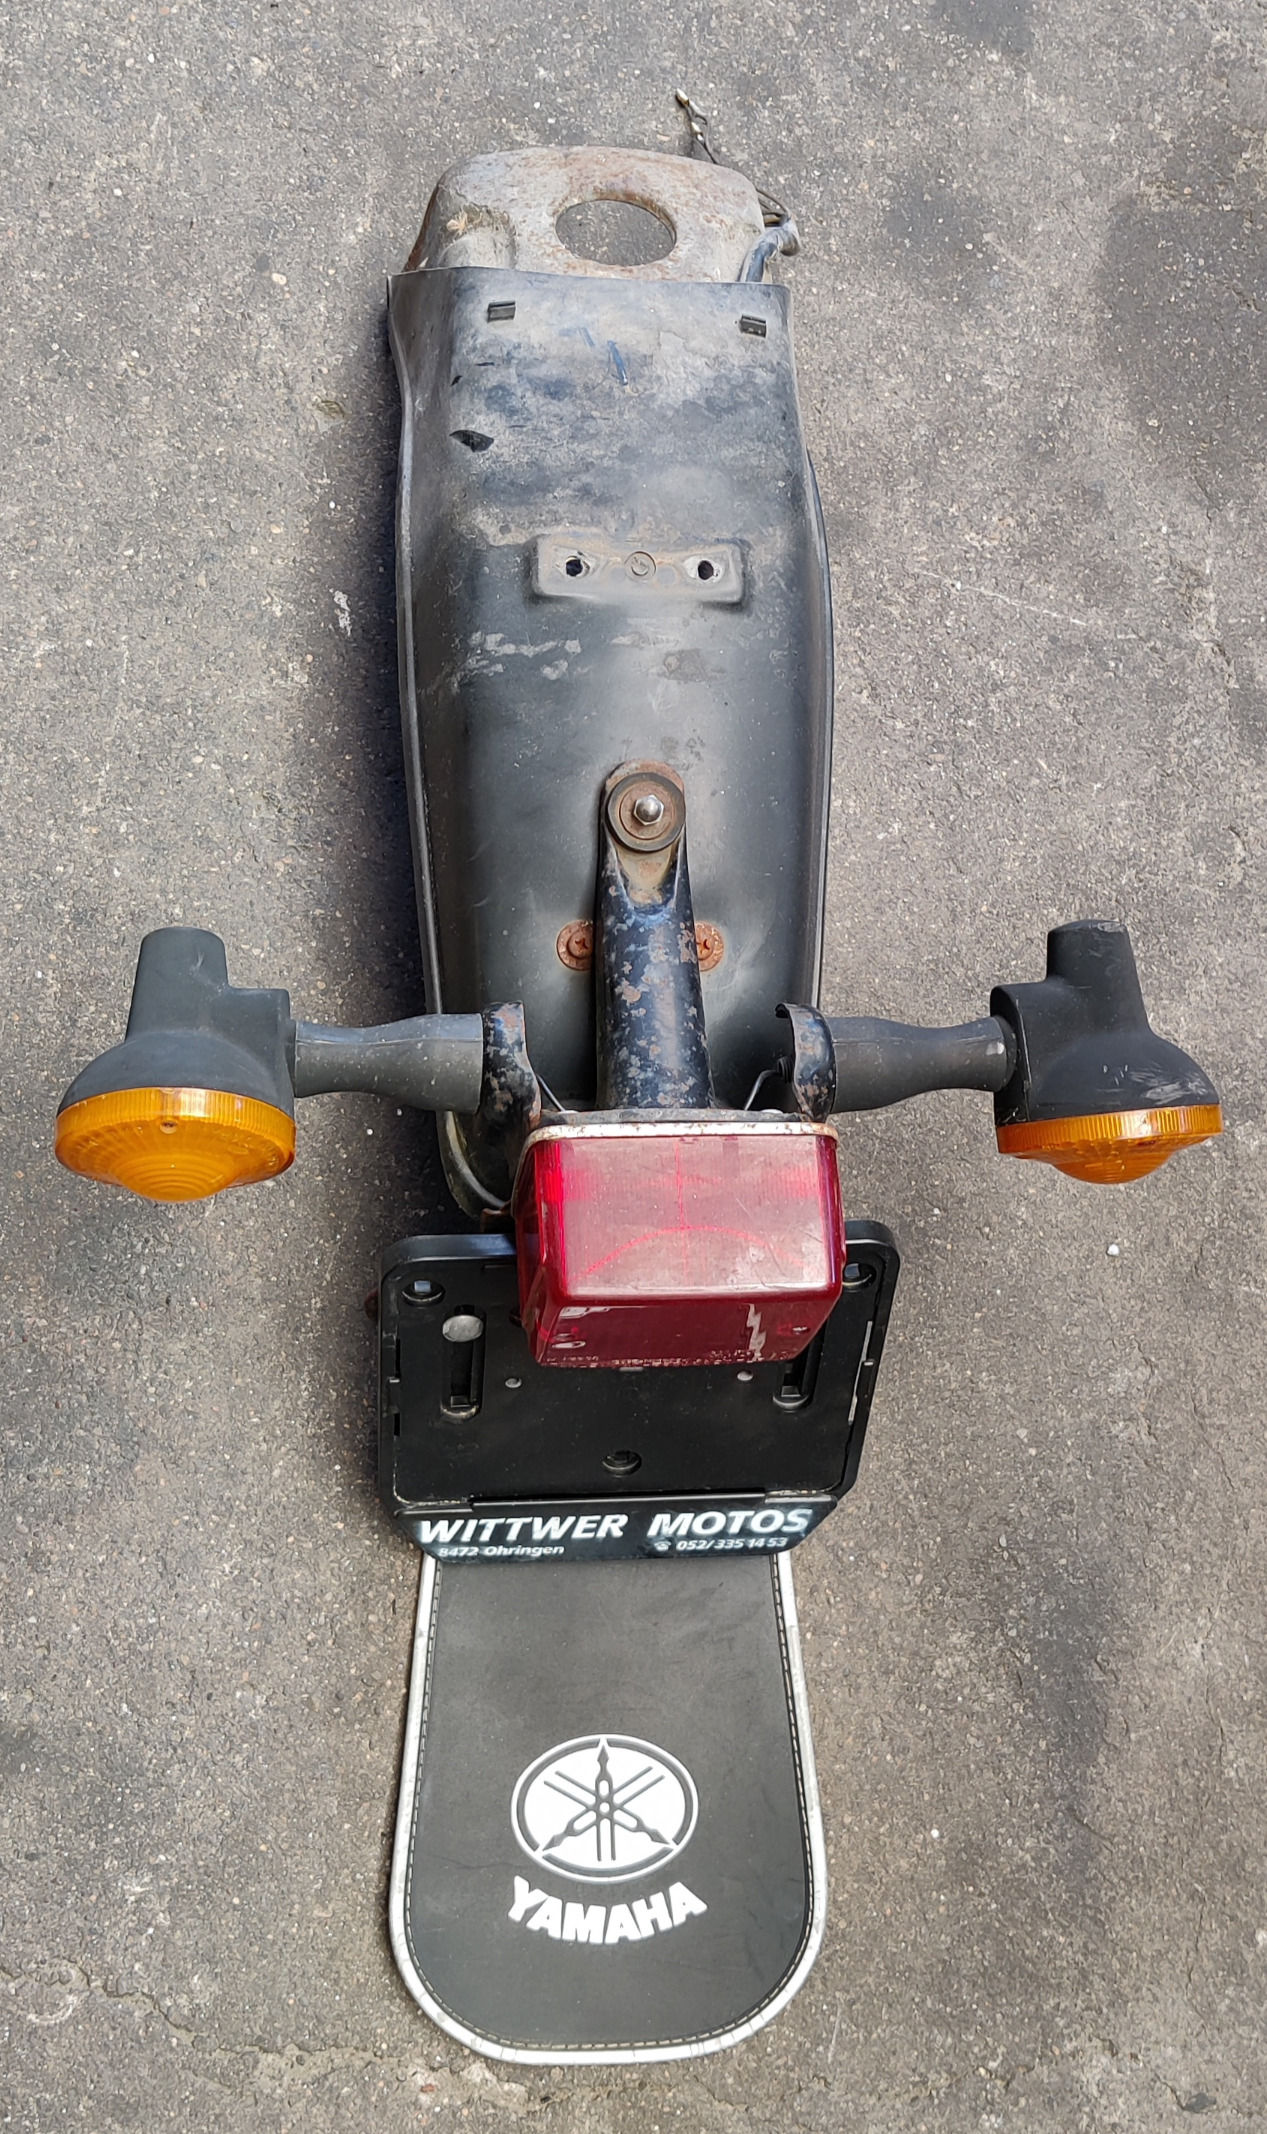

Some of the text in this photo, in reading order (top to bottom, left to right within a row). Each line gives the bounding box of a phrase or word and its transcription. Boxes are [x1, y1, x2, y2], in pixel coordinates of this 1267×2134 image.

[418, 1508, 813, 1543] WITTWER MOTOS
[438, 1545, 565, 1557] 8472 Ohringen
[507, 1875, 708, 1944] YAMAHA
